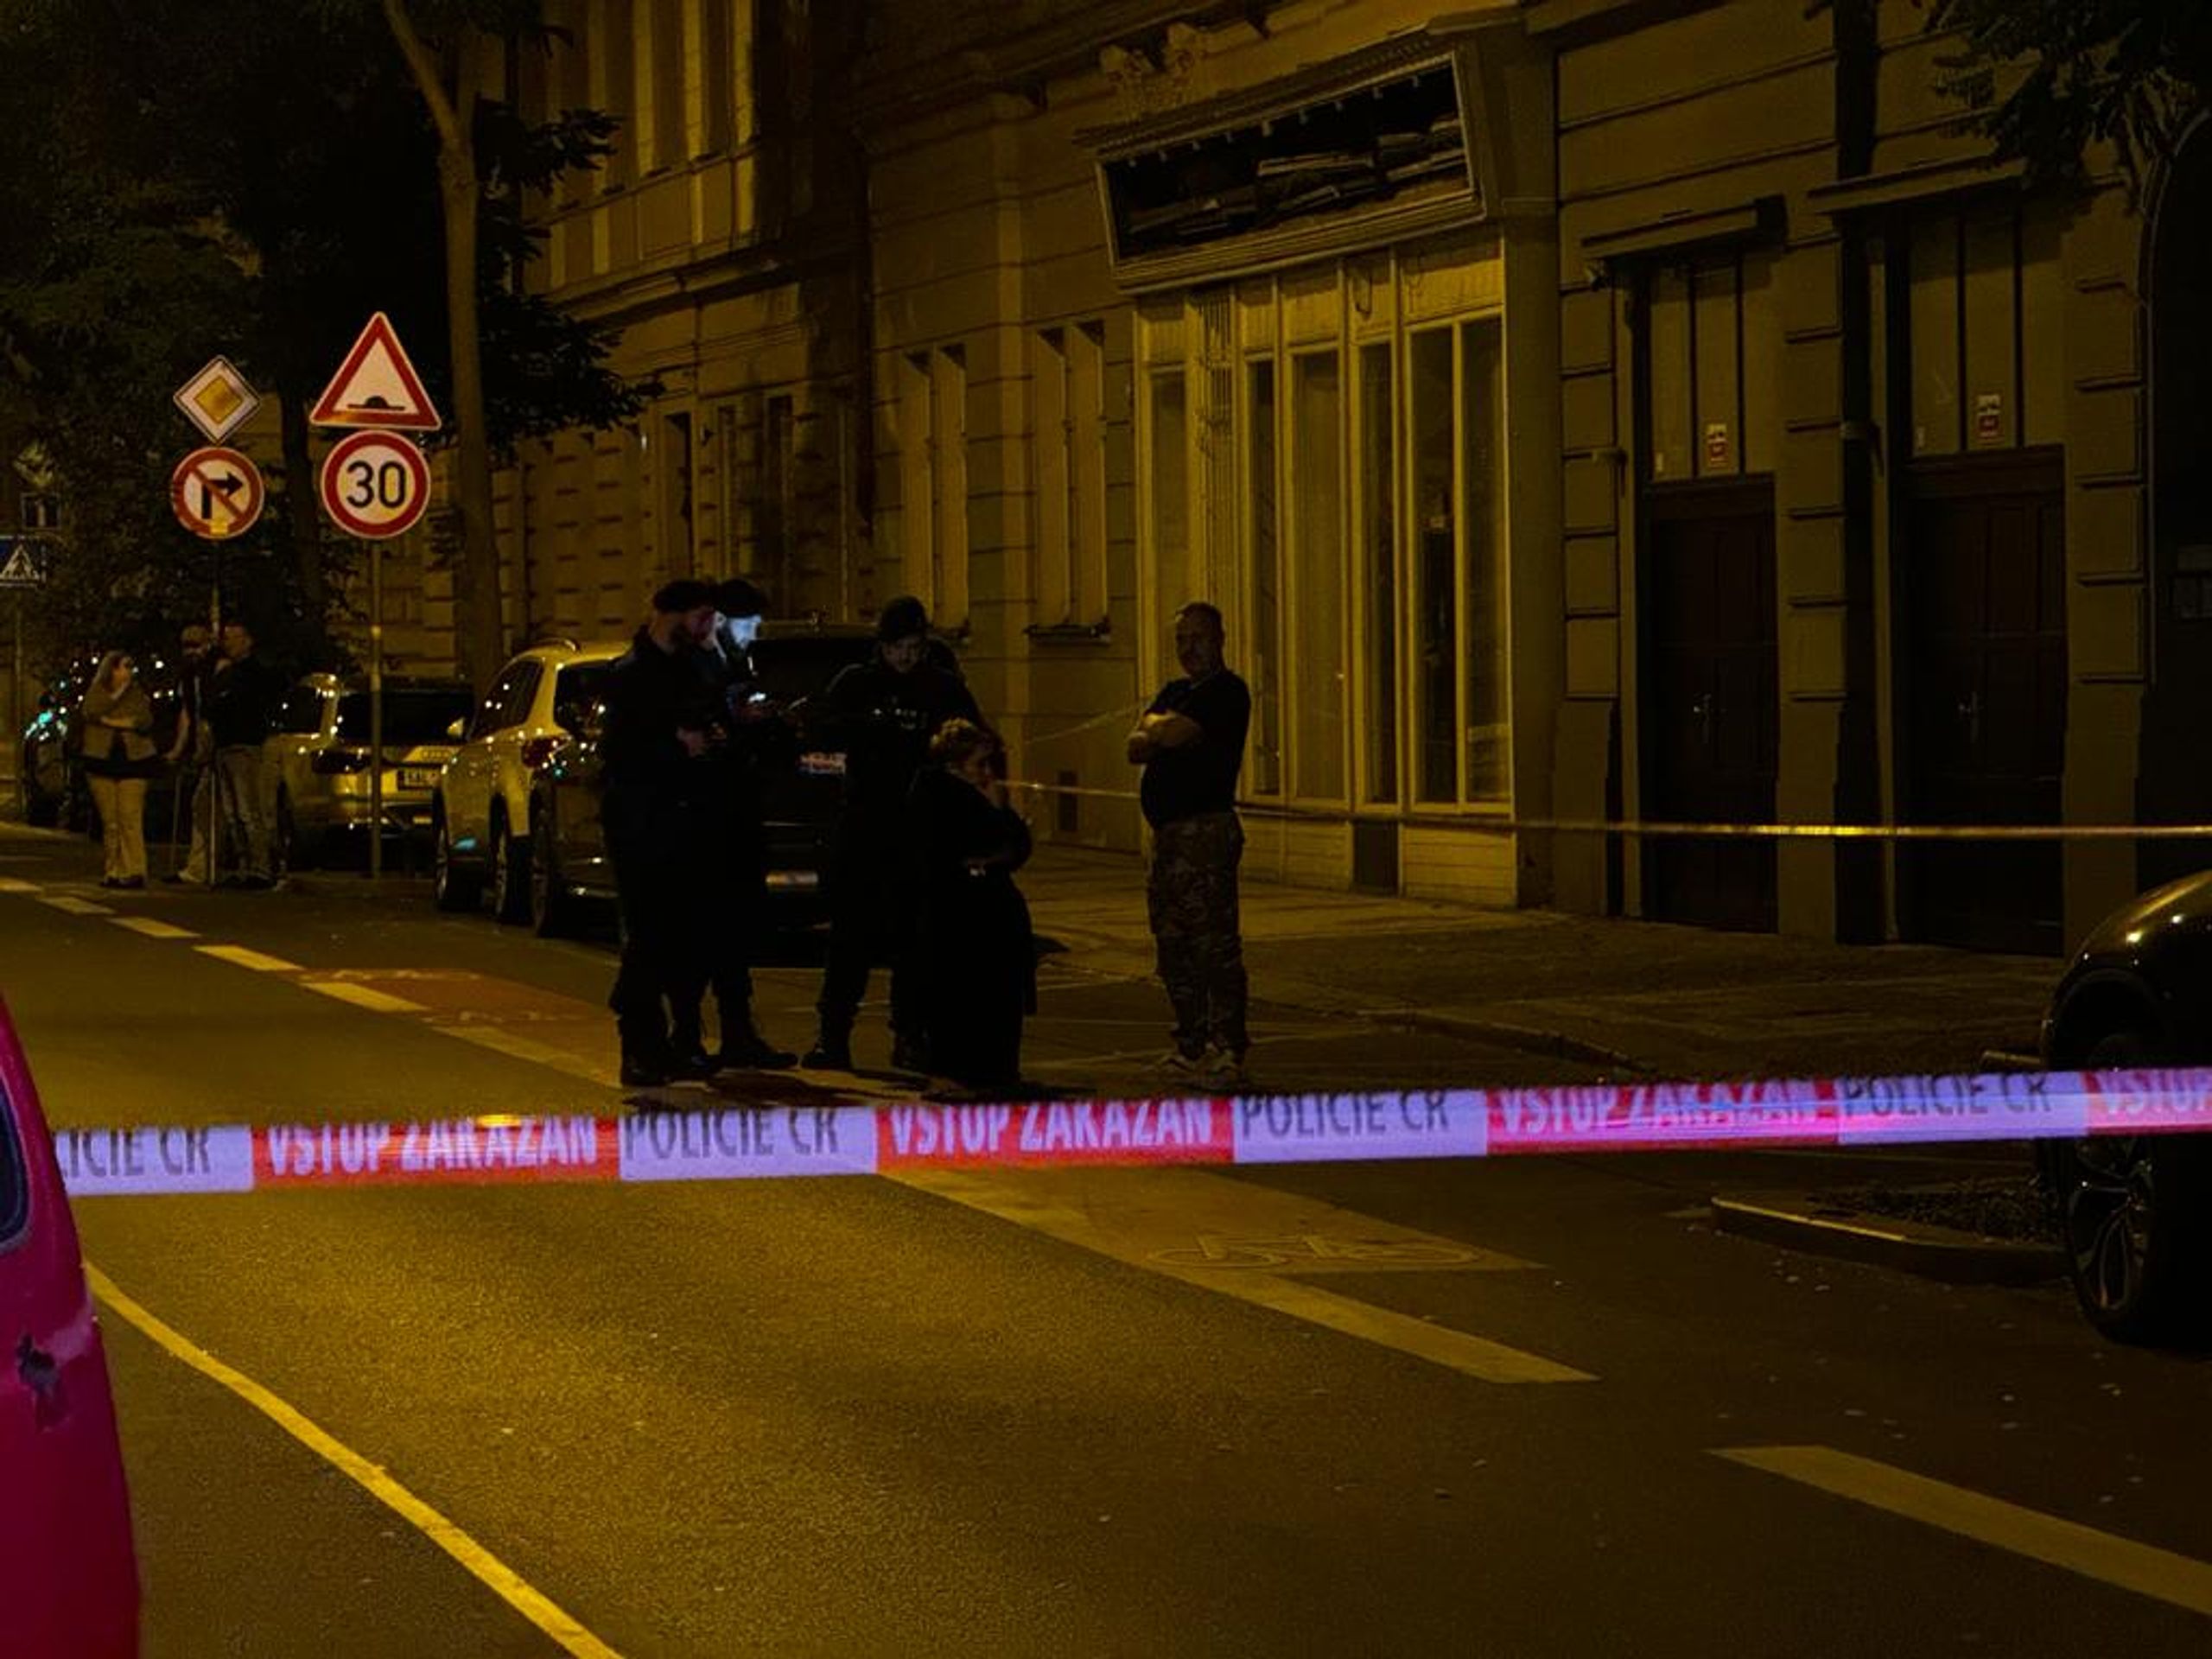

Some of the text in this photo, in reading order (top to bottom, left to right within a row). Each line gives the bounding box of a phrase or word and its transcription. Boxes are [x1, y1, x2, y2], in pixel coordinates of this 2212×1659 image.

[346, 461, 407, 509] 30
[269, 1123, 390, 1177] VSTUP
[624, 1109, 774, 1160] POLICIE
[888, 1104, 1009, 1155] VSTUP
[1240, 1093, 1388, 1141] POLICIE
[1499, 1088, 1619, 1135] VSTUP
[1839, 1074, 1989, 1118] POLICIE
